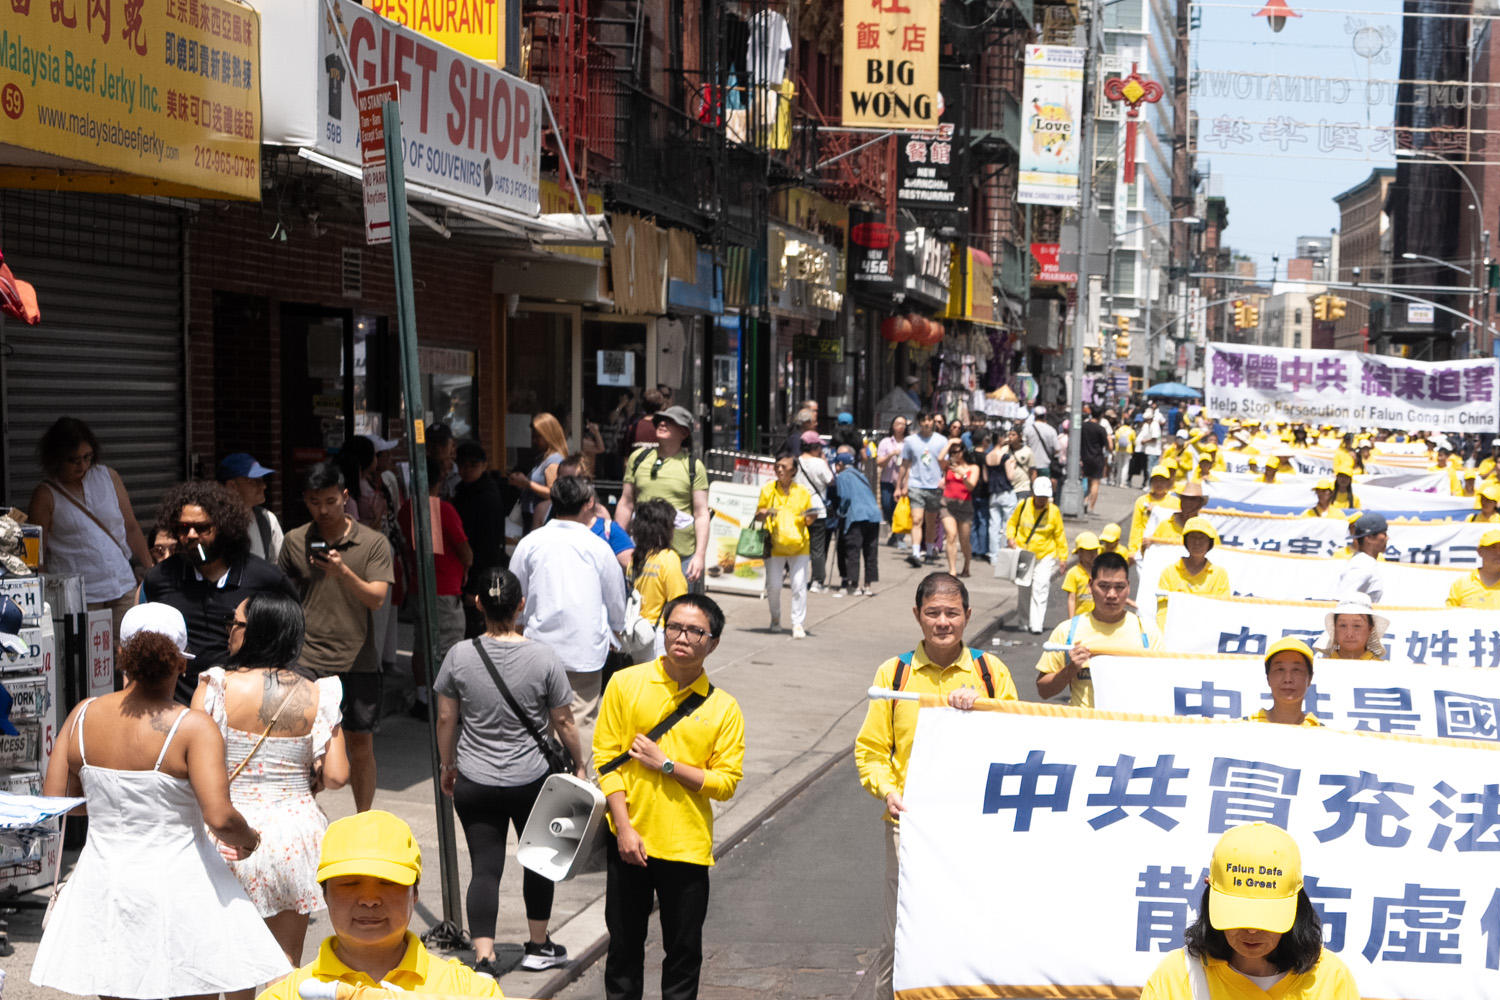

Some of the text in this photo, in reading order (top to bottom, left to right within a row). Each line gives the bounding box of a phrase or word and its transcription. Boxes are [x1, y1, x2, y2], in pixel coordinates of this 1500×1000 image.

[857, 21, 926, 53] 飯店
[0, 30, 161, 114] Malaysia Beef Jerky Inc.
[867, 59, 914, 86] BIG
[6, 88, 22, 114] 59
[350, 16, 530, 165] GIFT SHOP
[851, 91, 931, 120] WONG
[38, 105, 179, 162] www.malaysiabeefjerky.com
[1035, 118, 1071, 133] Love
[194, 145, 255, 180] 212-965-0796
[410, 141, 423, 168] OF
[426, 149, 482, 188] SOUVENIRS
[917, 167, 937, 178] NEW
[899, 189, 956, 202] RESTAURANT
[861, 261, 888, 274] 456
[1211, 350, 1495, 403] 解體中共 結束迫害
[1210, 397, 1238, 413] Help
[1242, 398, 1271, 415] Stop
[1274, 400, 1349, 419] Persecution
[1354, 404, 1367, 419] of
[1369, 406, 1402, 421] Falun
[1408, 409, 1439, 426] Gong
[1460, 411, 1494, 425] China
[94, 630, 110, 652] 中醫
[1226, 863, 1283, 876] Falun Dafa
[1246, 878, 1277, 889] Great
